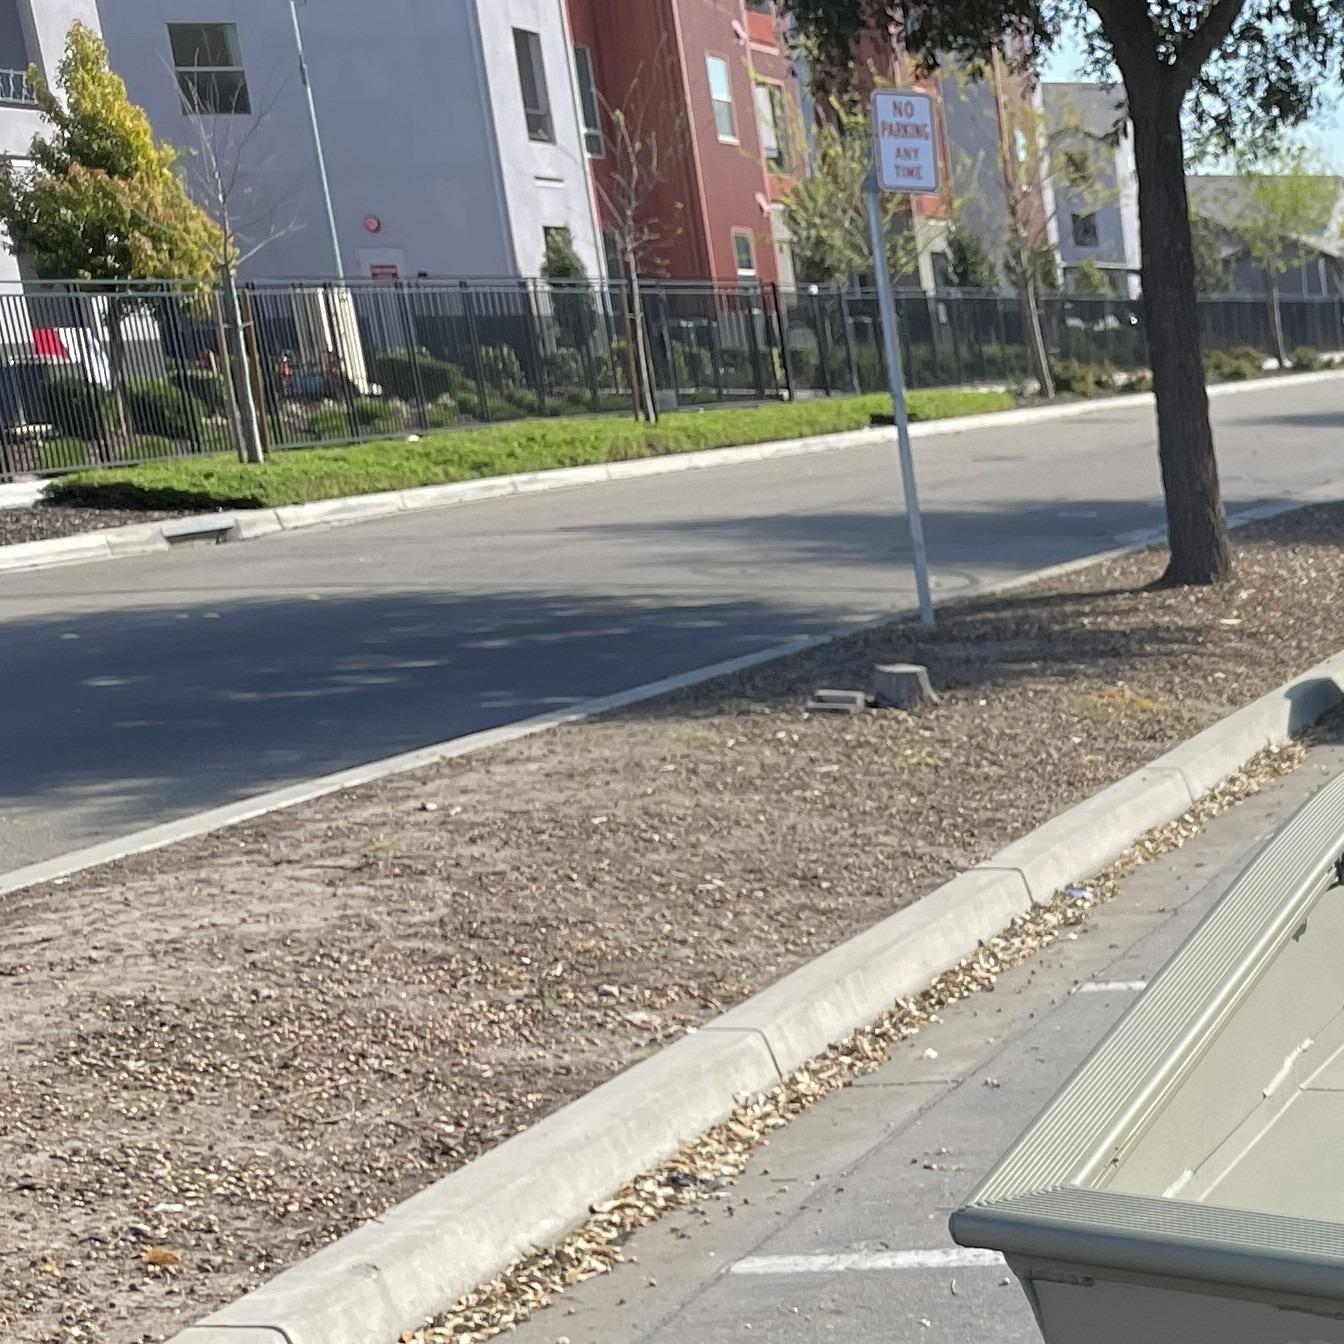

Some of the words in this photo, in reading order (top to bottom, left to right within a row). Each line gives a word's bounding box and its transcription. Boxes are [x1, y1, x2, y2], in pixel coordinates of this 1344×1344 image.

[892, 100, 914, 118] NO
[880, 120, 930, 141] PARKING
[895, 147, 920, 161] ANY
[895, 164, 923, 180] TIME
